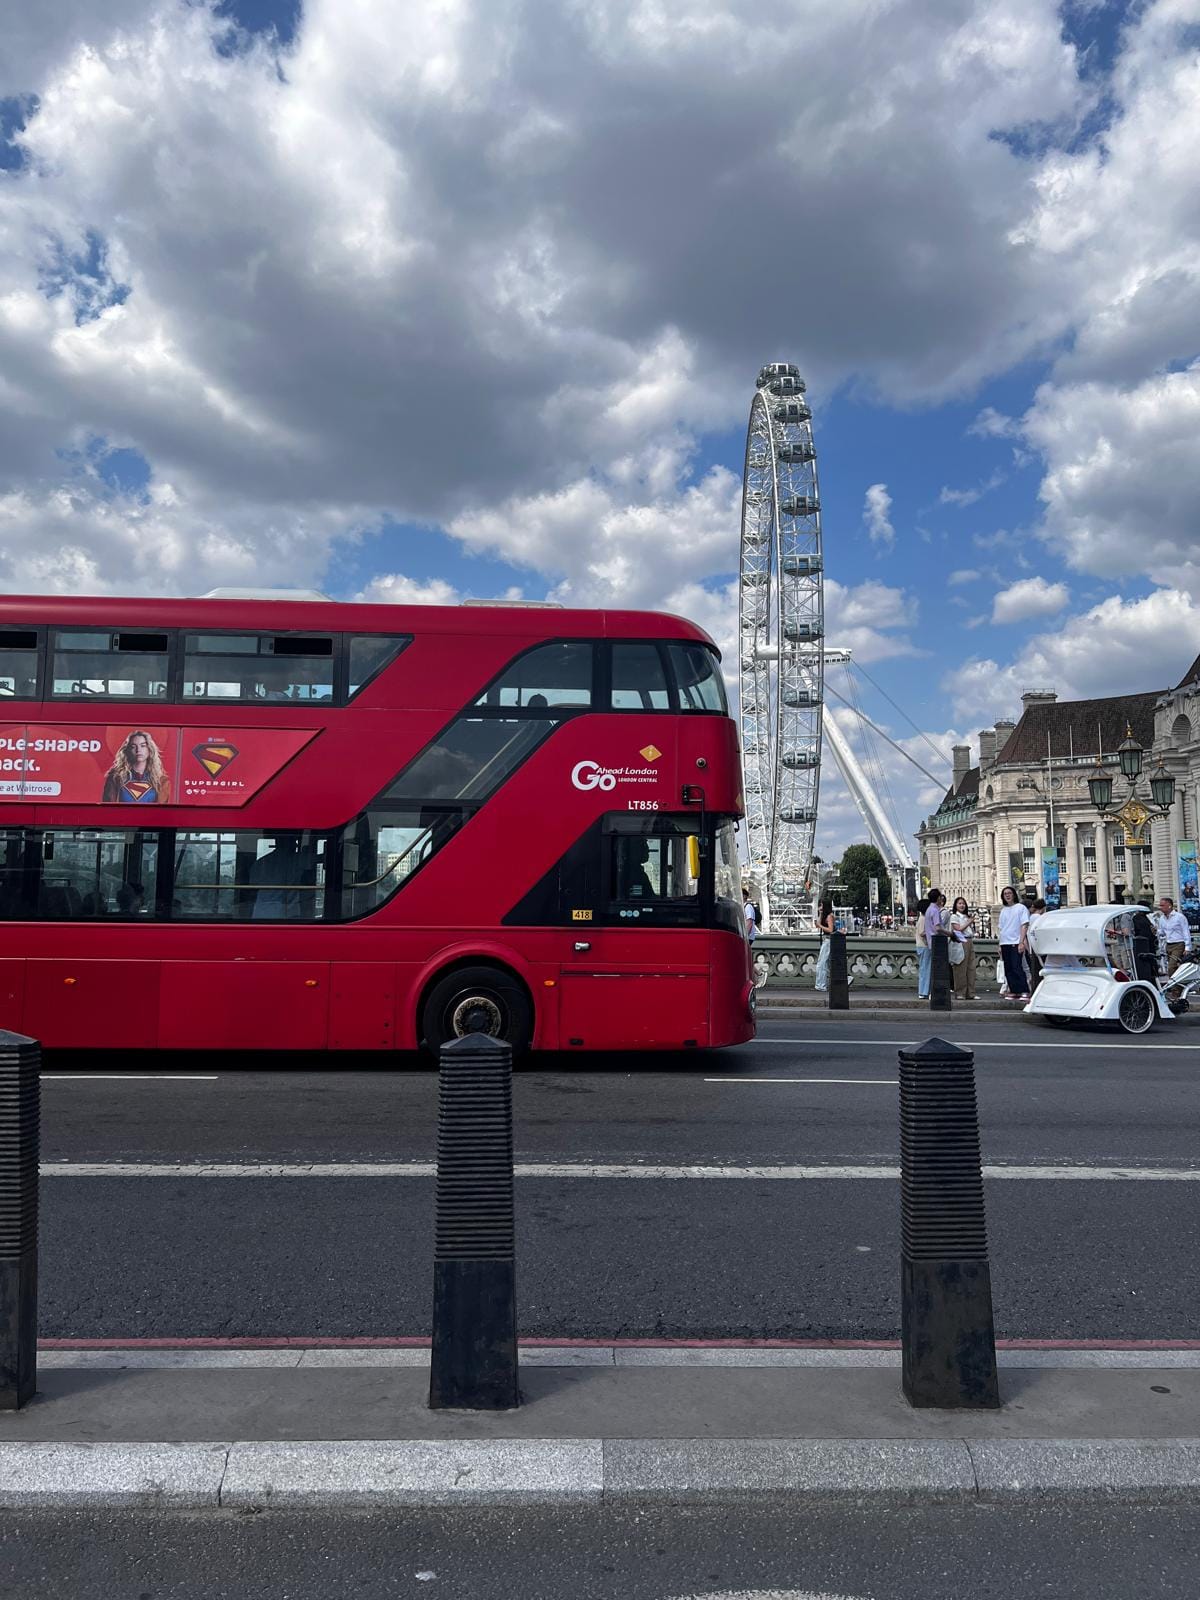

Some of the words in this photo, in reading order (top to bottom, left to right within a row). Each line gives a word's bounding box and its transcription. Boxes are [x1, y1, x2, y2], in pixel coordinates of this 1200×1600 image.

[0, 758, 41, 771] ack.
[571, 760, 617, 791] Go
[596, 767, 623, 775] Ahead
[625, 767, 658, 775] London
[16, 785, 52, 793] Waitrose
[628, 800, 659, 810] LT856
[574, 911, 590, 919] 418
